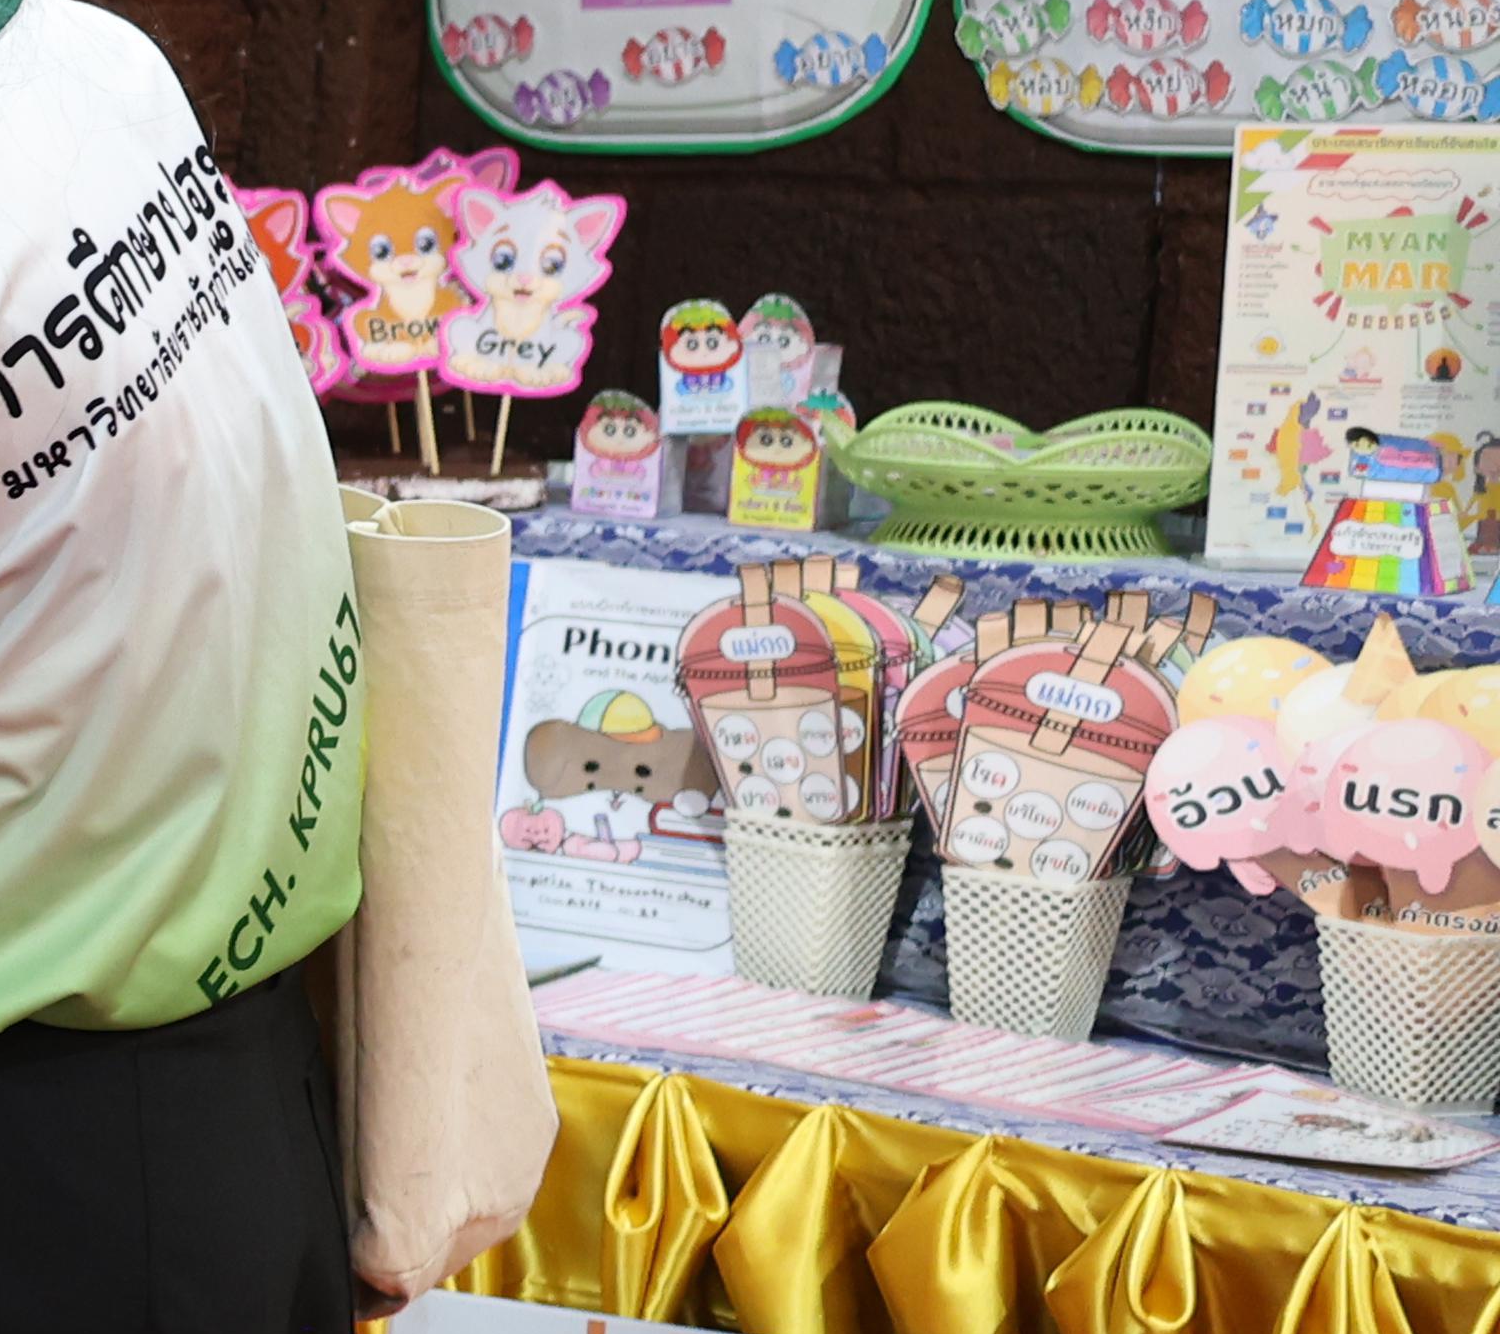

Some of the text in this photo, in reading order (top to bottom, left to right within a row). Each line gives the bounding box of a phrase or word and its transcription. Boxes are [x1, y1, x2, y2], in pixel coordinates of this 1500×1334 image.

[1346, 231, 1448, 251] MYAN
[1342, 262, 1452, 289] MAR
[475, 328, 558, 369] Grey
[732, 631, 790, 657] แม่กก
[1038, 681, 1112, 719] แม่กก
[290, 591, 365, 855] KPRU67
[1169, 767, 1285, 829] อ้วน
[1344, 780, 1462, 825] นรก
